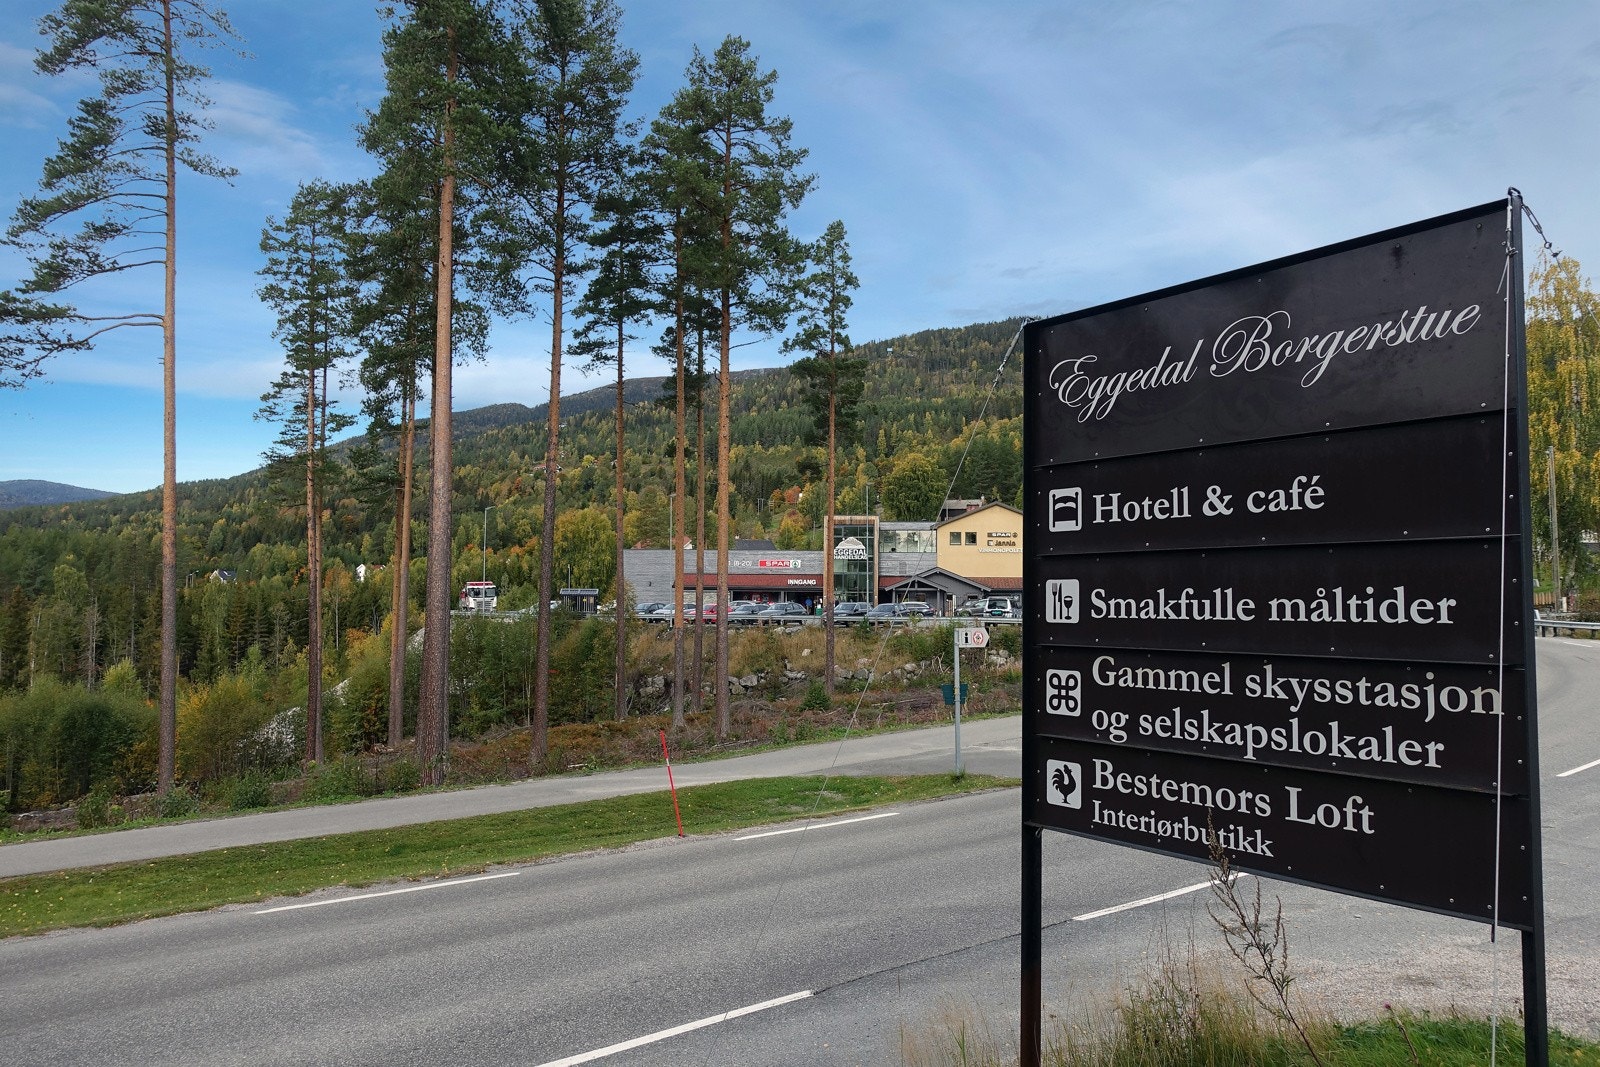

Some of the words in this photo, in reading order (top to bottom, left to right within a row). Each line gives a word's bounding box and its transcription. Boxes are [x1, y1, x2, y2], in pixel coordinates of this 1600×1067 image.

[1048, 338, 1205, 424] Eggedal
[1209, 304, 1482, 388] Borgerstue
[1092, 486, 1192, 524] Hotell
[1202, 485, 1234, 517] &
[1246, 475, 1325, 514] café
[1090, 587, 1256, 622] Smakfulle
[1268, 585, 1457, 625] måltider
[1092, 655, 1234, 695] Gammel
[1245, 664, 1505, 723] skysstasjon
[1091, 709, 1129, 744] og
[1139, 706, 1445, 769] selskapslokaler
[1092, 758, 1272, 817] Bestemors
[1284, 785, 1375, 835] Loft
